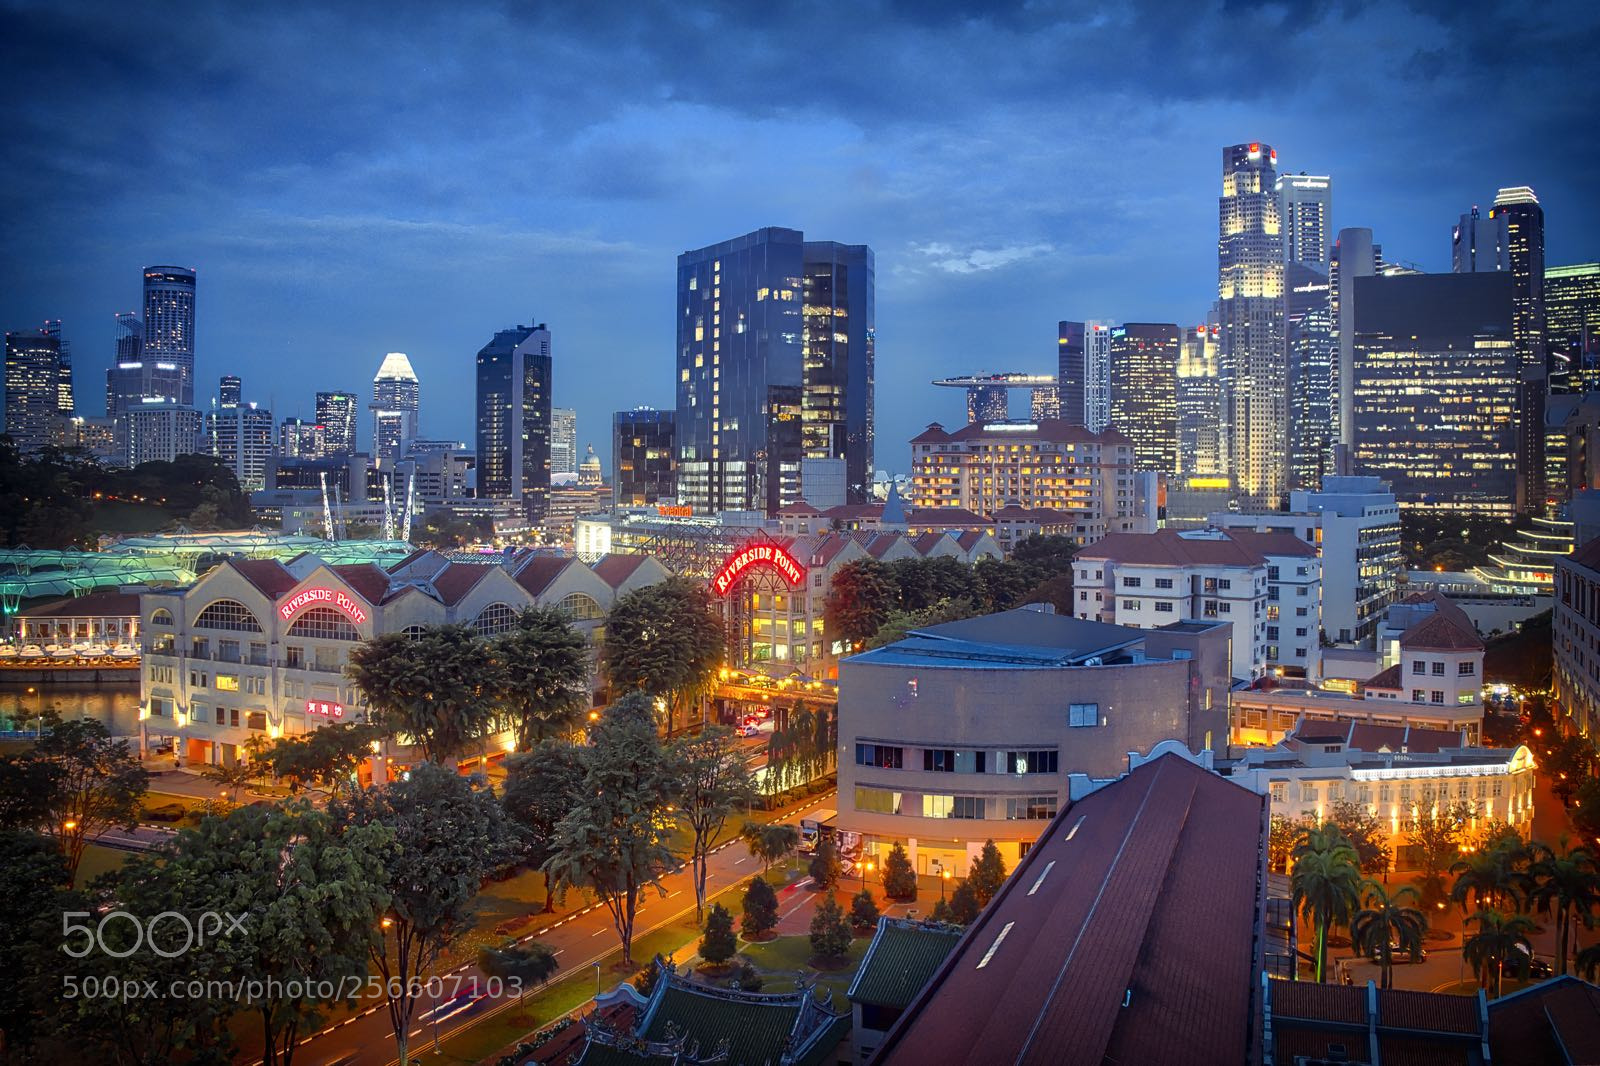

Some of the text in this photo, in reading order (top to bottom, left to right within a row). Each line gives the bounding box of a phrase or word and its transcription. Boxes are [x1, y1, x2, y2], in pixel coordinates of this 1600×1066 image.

[717, 547, 801, 593] RIVERSIDE POINT
[281, 589, 365, 624] RIVERSIDE POINT
